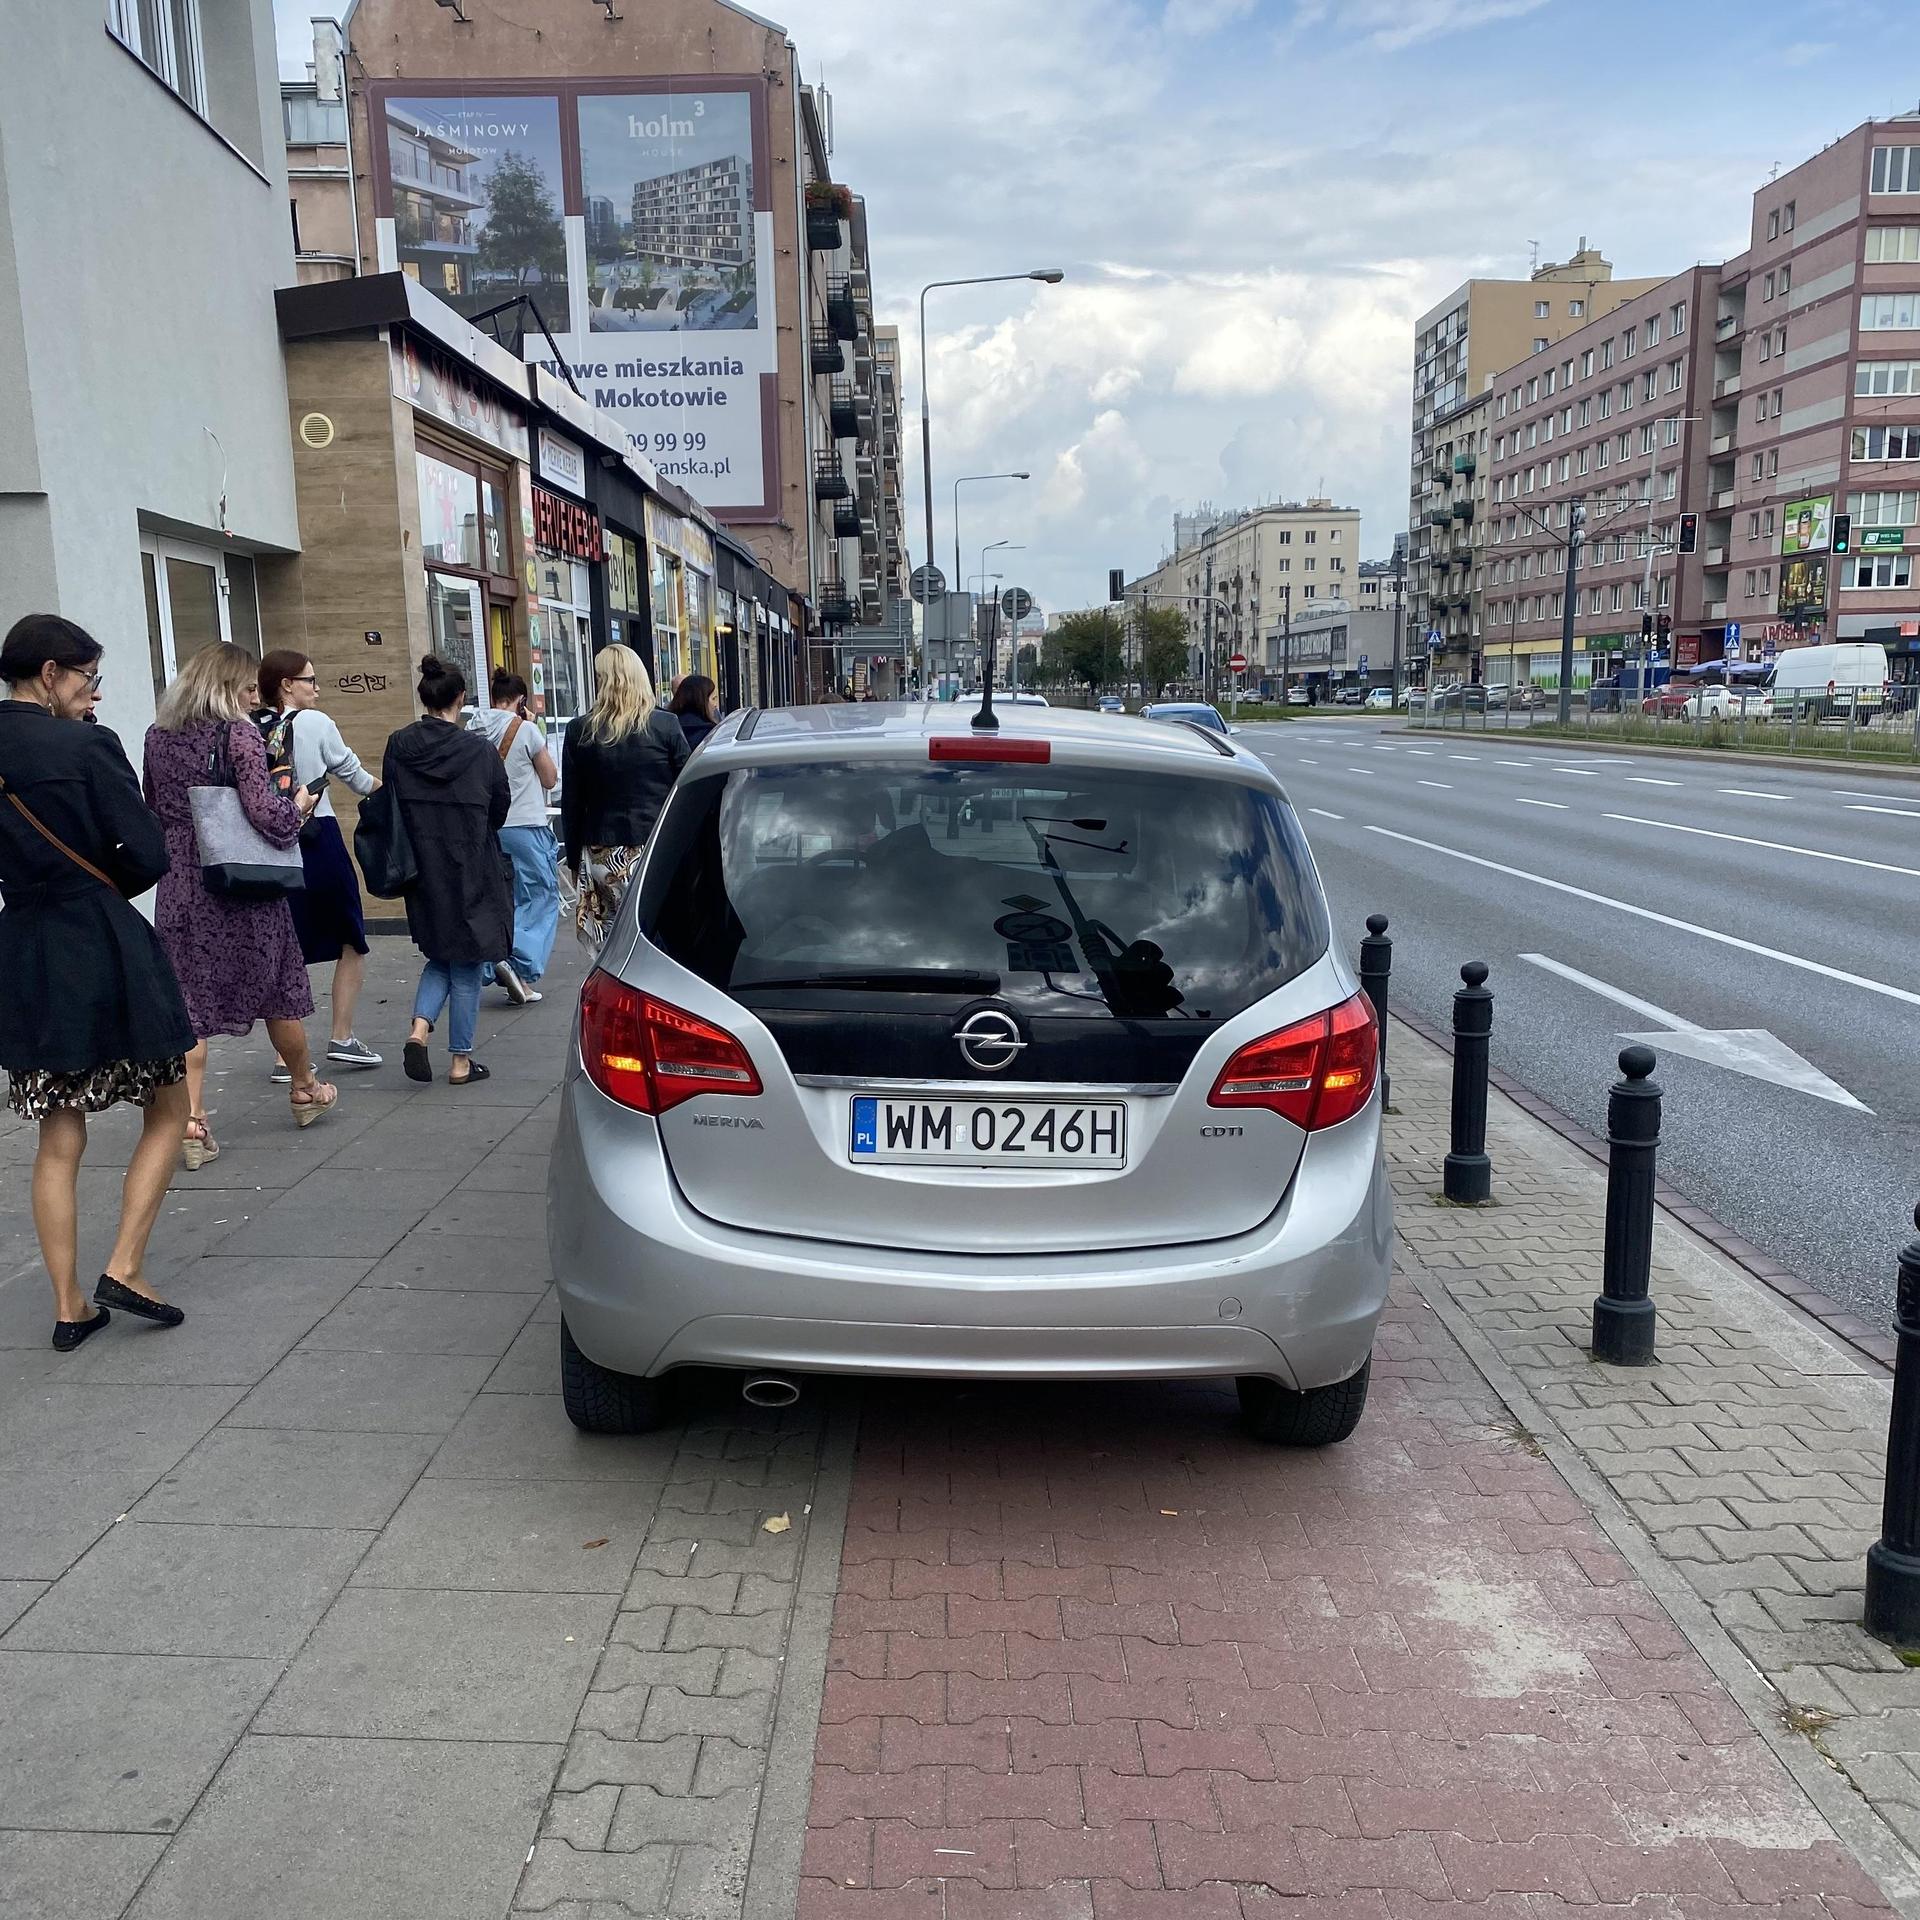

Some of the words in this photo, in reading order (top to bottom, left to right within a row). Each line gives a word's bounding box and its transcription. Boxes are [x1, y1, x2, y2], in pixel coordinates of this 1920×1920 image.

[414, 121, 529, 137] JAŚMINOWY
[615, 356, 744, 378] mieszkania
[595, 387, 728, 408] Mokotowie
[653, 433, 677, 452] 99
[683, 432, 706, 451] 99
[490, 528, 500, 558] 12
[877, 656, 887, 664] M
[1651, 652, 1659, 661] P
[692, 1113, 766, 1130] MERIVA
[885, 1104, 953, 1151] WM
[971, 1106, 1118, 1155] 0246H
[857, 1133, 874, 1145] PL
[1200, 1125, 1244, 1138] CDTI
